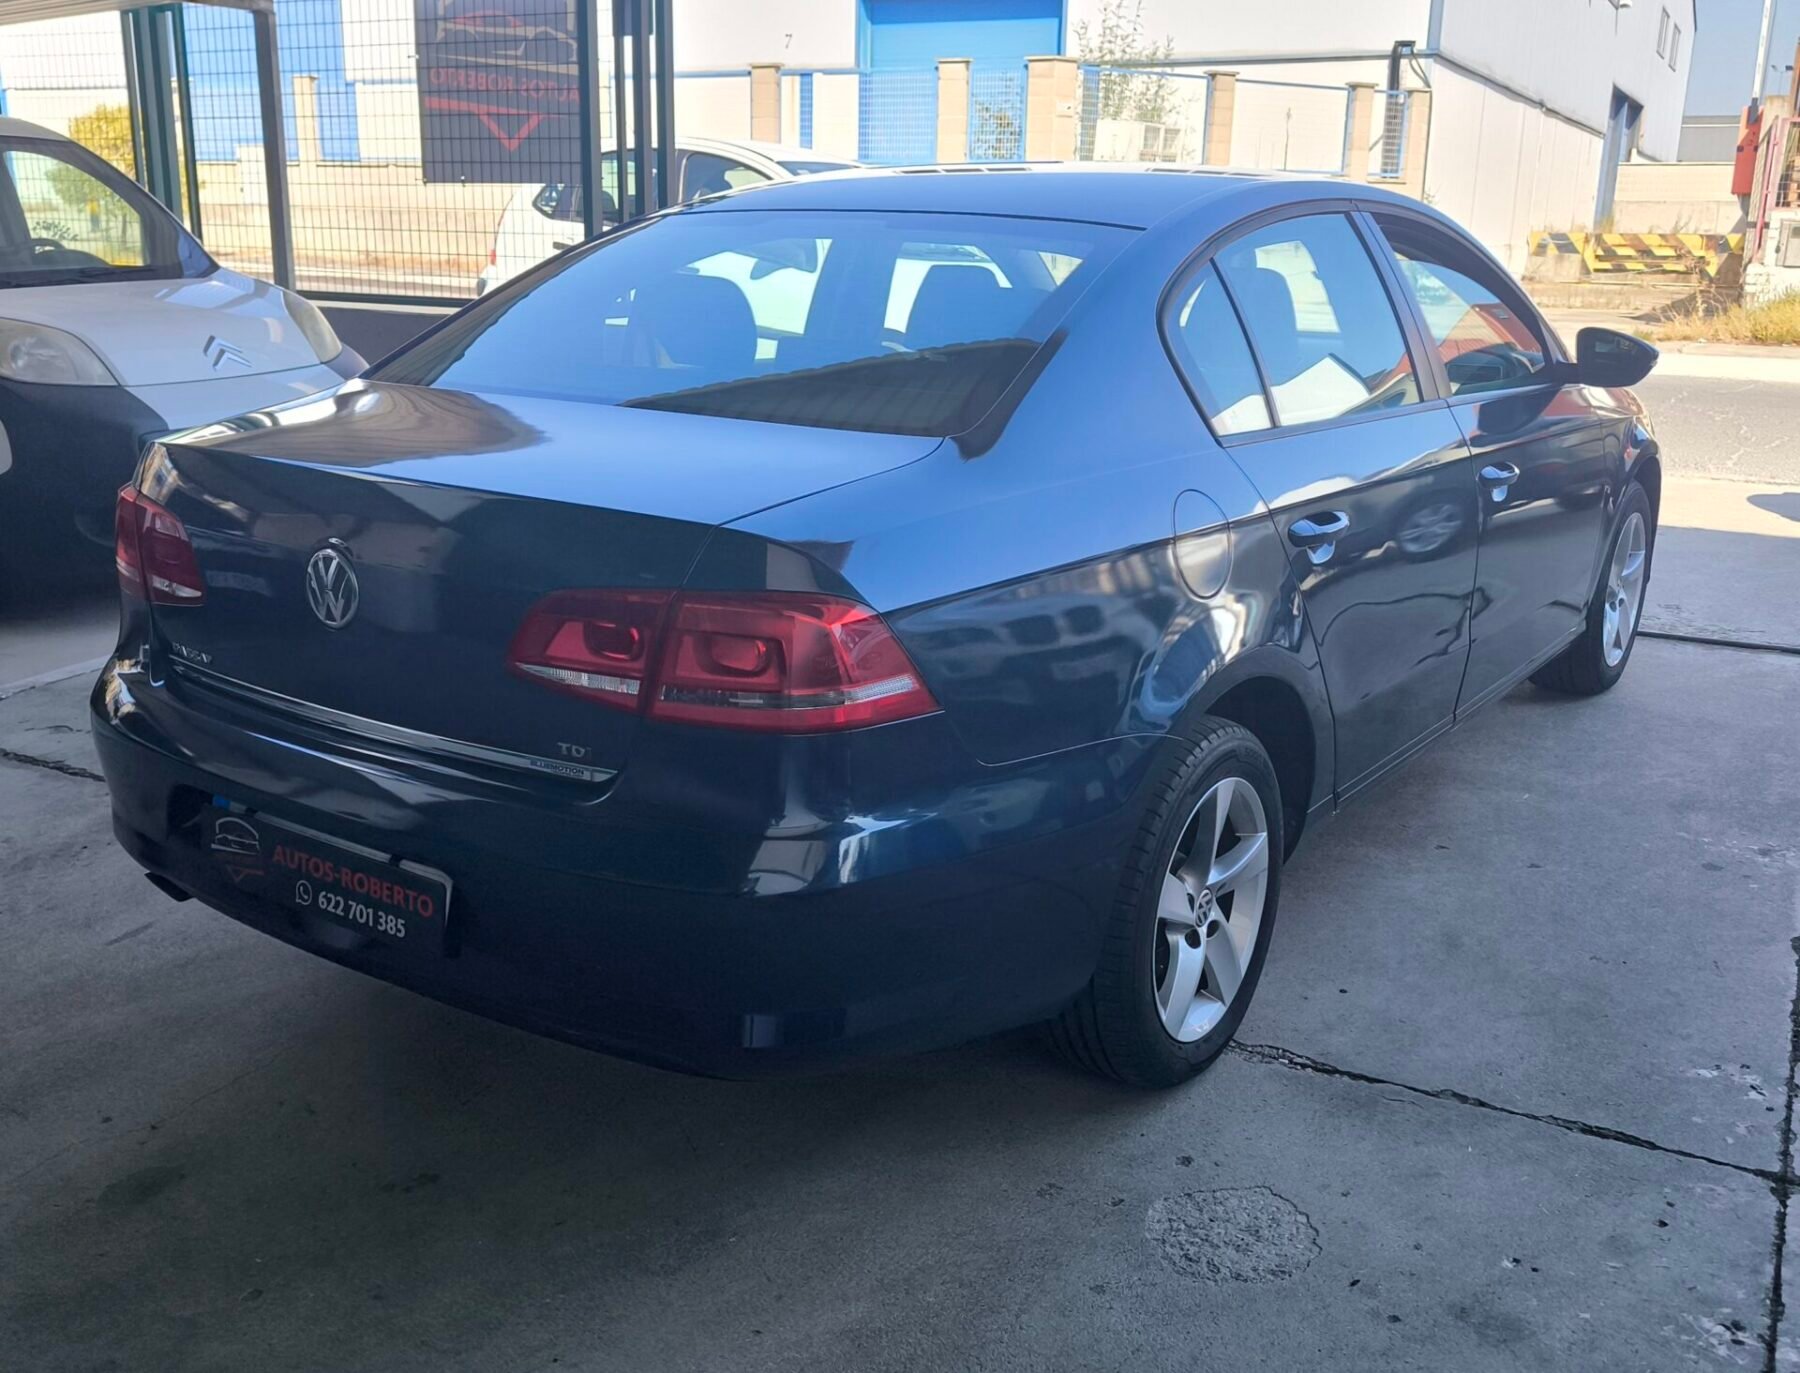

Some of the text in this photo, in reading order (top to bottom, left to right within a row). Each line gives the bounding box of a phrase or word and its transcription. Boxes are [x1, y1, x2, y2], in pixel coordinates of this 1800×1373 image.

[272, 845, 434, 917] AUTOS-ROBERTO
[318, 891, 406, 938] 622 701 385
